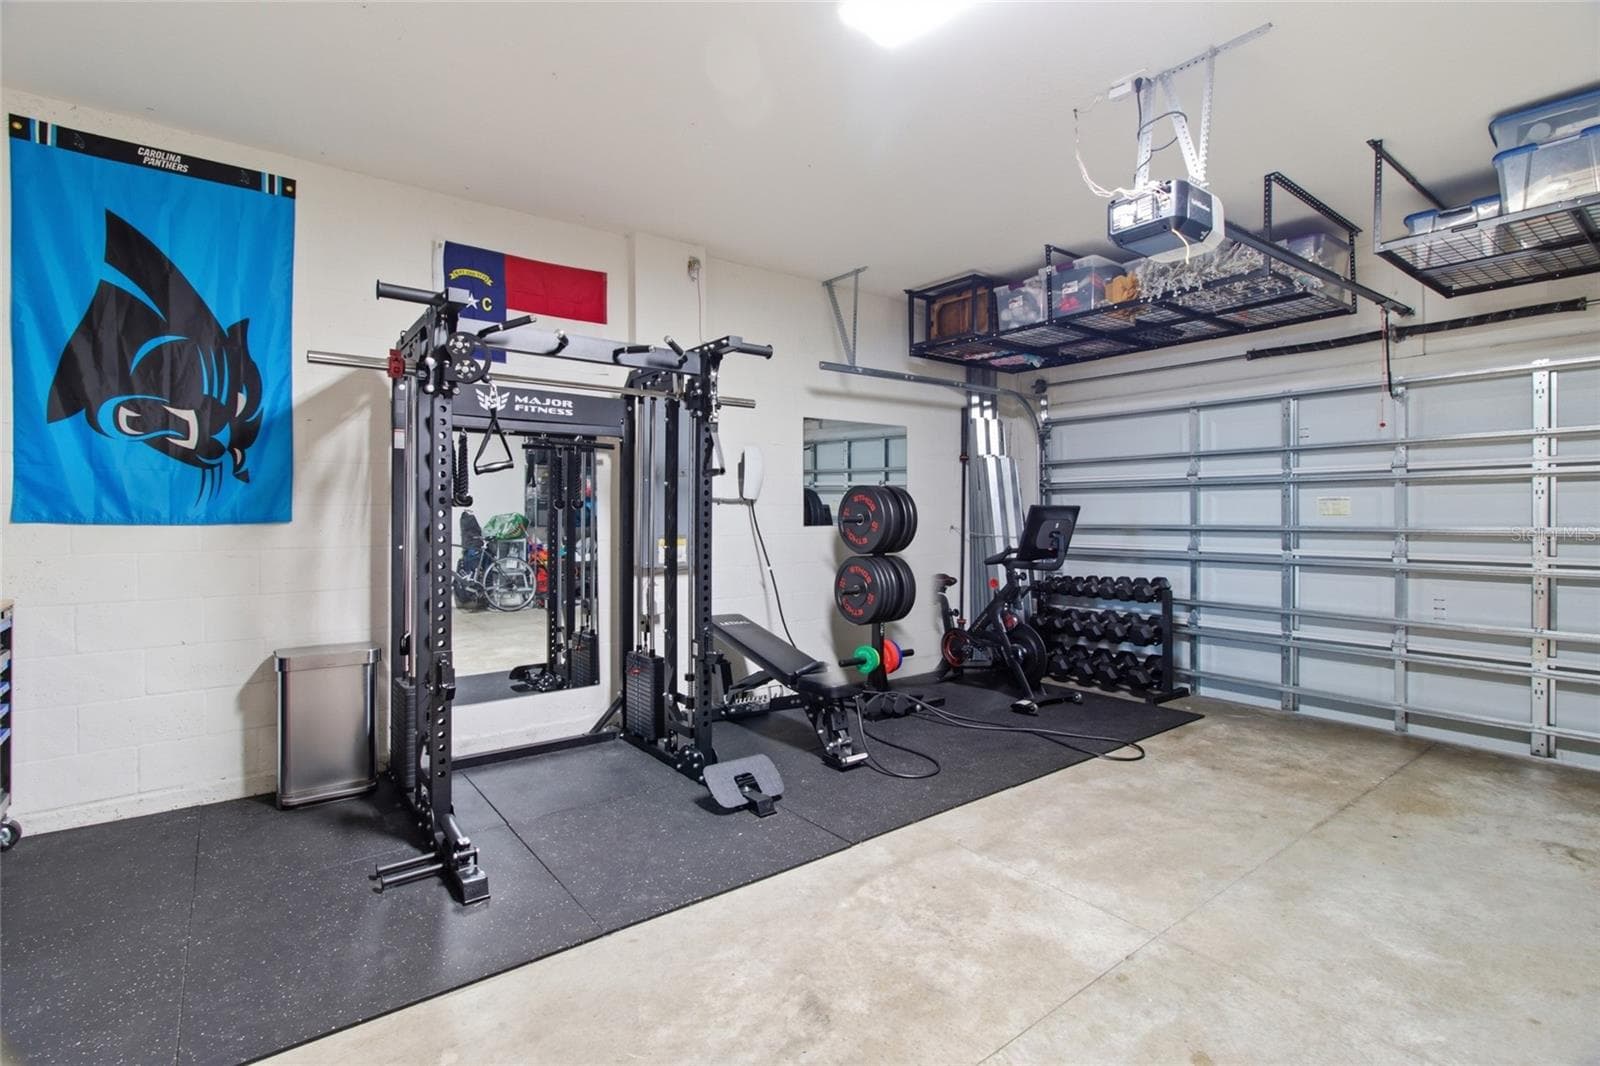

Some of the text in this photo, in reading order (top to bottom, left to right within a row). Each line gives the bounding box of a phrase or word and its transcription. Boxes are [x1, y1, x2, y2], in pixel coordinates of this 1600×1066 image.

[138, 146, 182, 163] CAROLINA
[143, 156, 189, 173] PANTHERS
[482, 297, 493, 312] C
[514, 394, 574, 408] MAJOR
[514, 404, 574, 416] FITNESS
